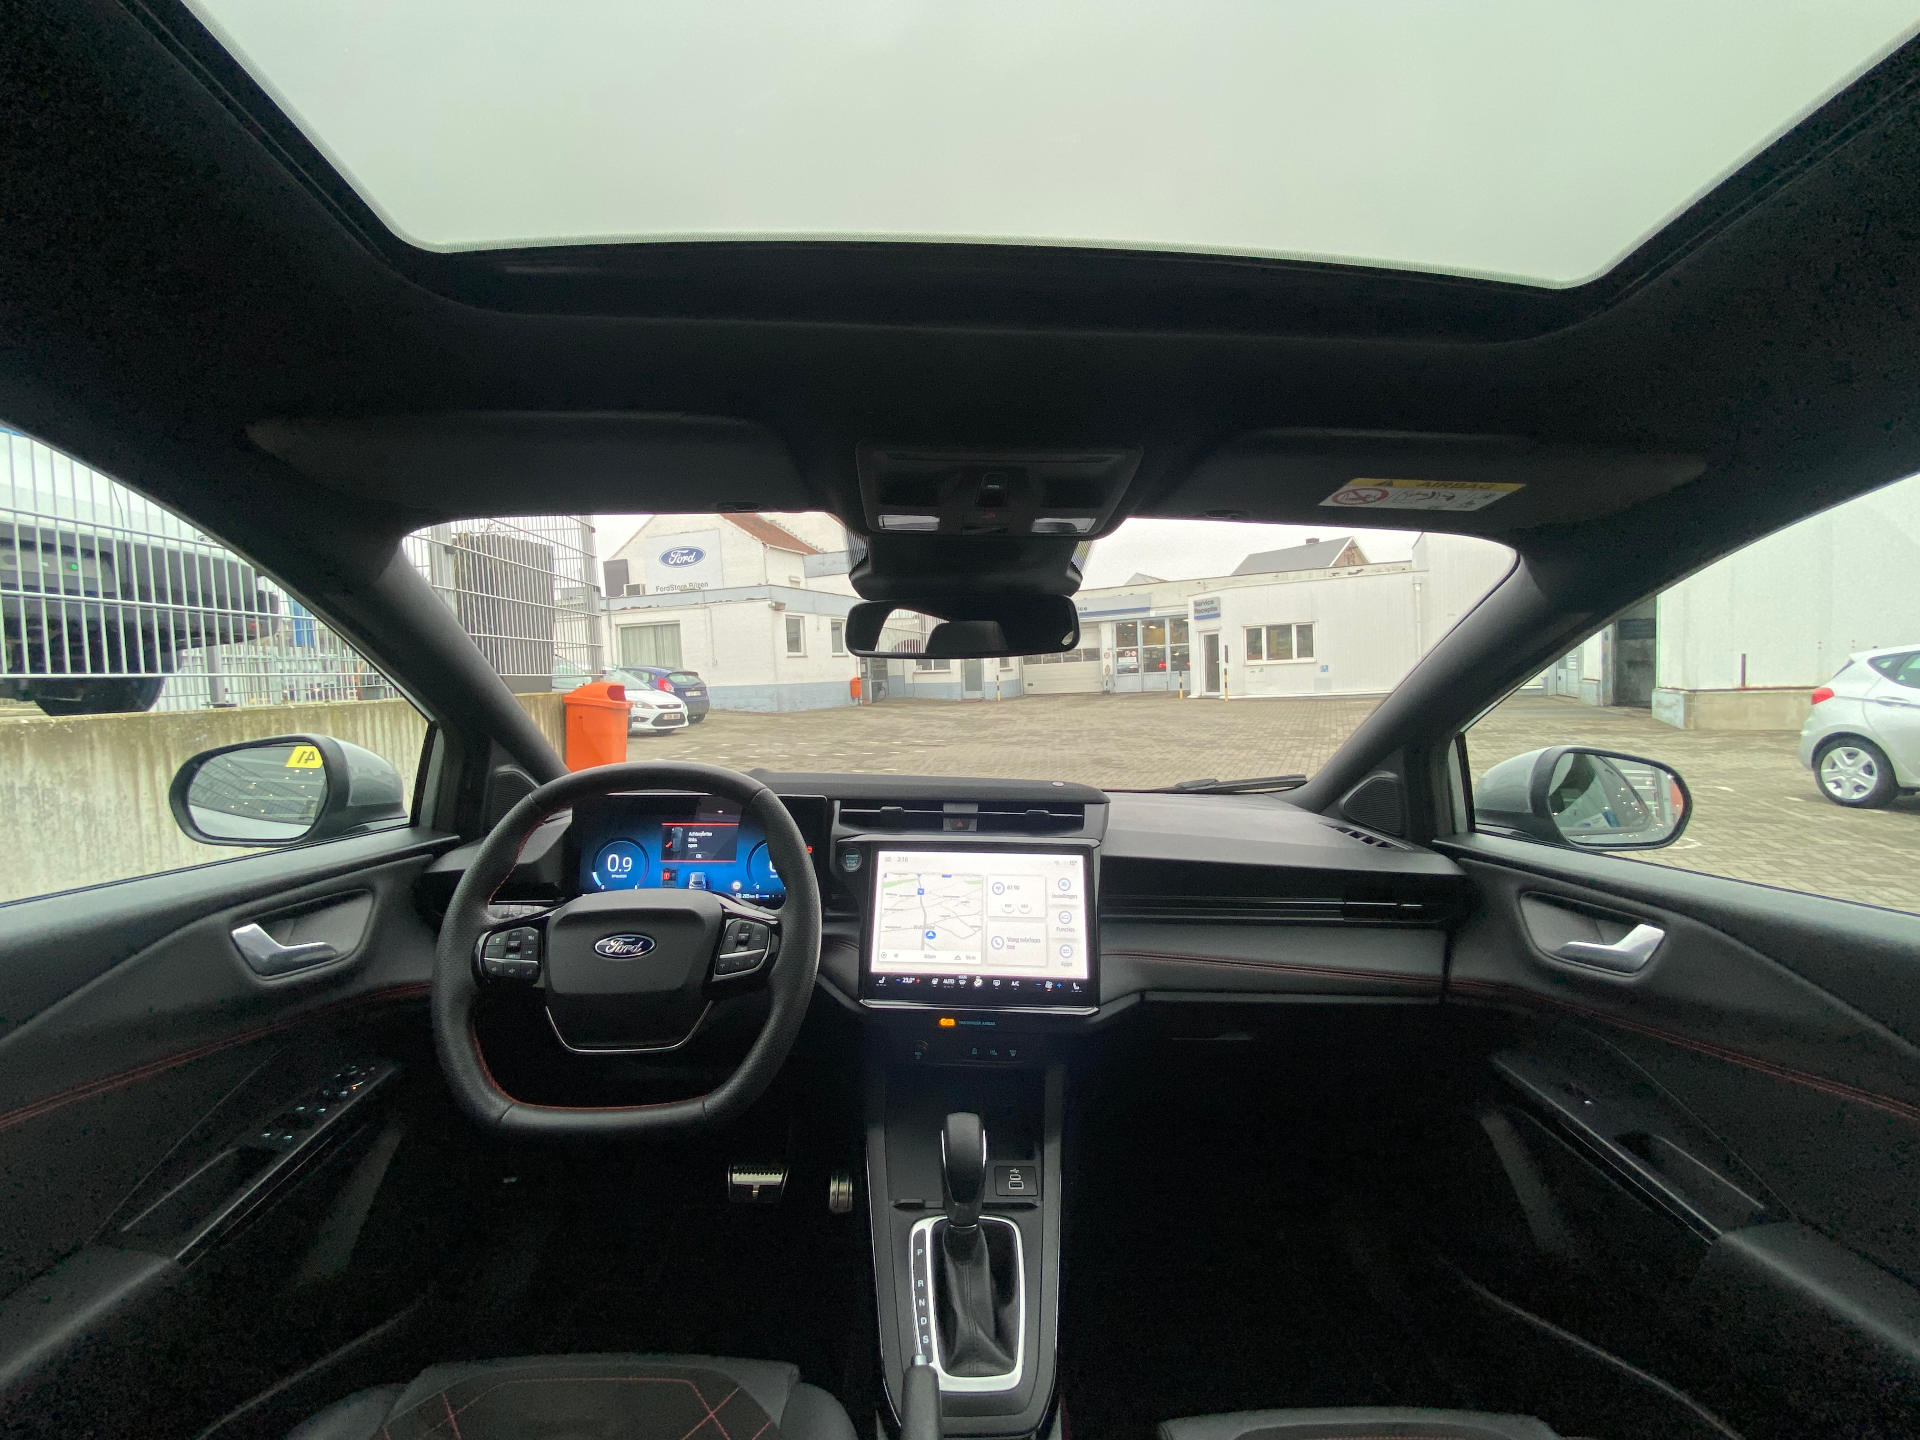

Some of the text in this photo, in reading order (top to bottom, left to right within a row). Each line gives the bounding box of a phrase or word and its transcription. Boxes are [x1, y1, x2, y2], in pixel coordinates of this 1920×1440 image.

[1416, 481, 1496, 490] AIRBAG
[1194, 599, 1215, 608] Service
[1194, 606, 1218, 615] Receptie
[607, 853, 633, 872] 0.9
[917, 1248, 923, 1256] P
[920, 1316, 927, 1325] D
[922, 1335, 929, 1344] S
